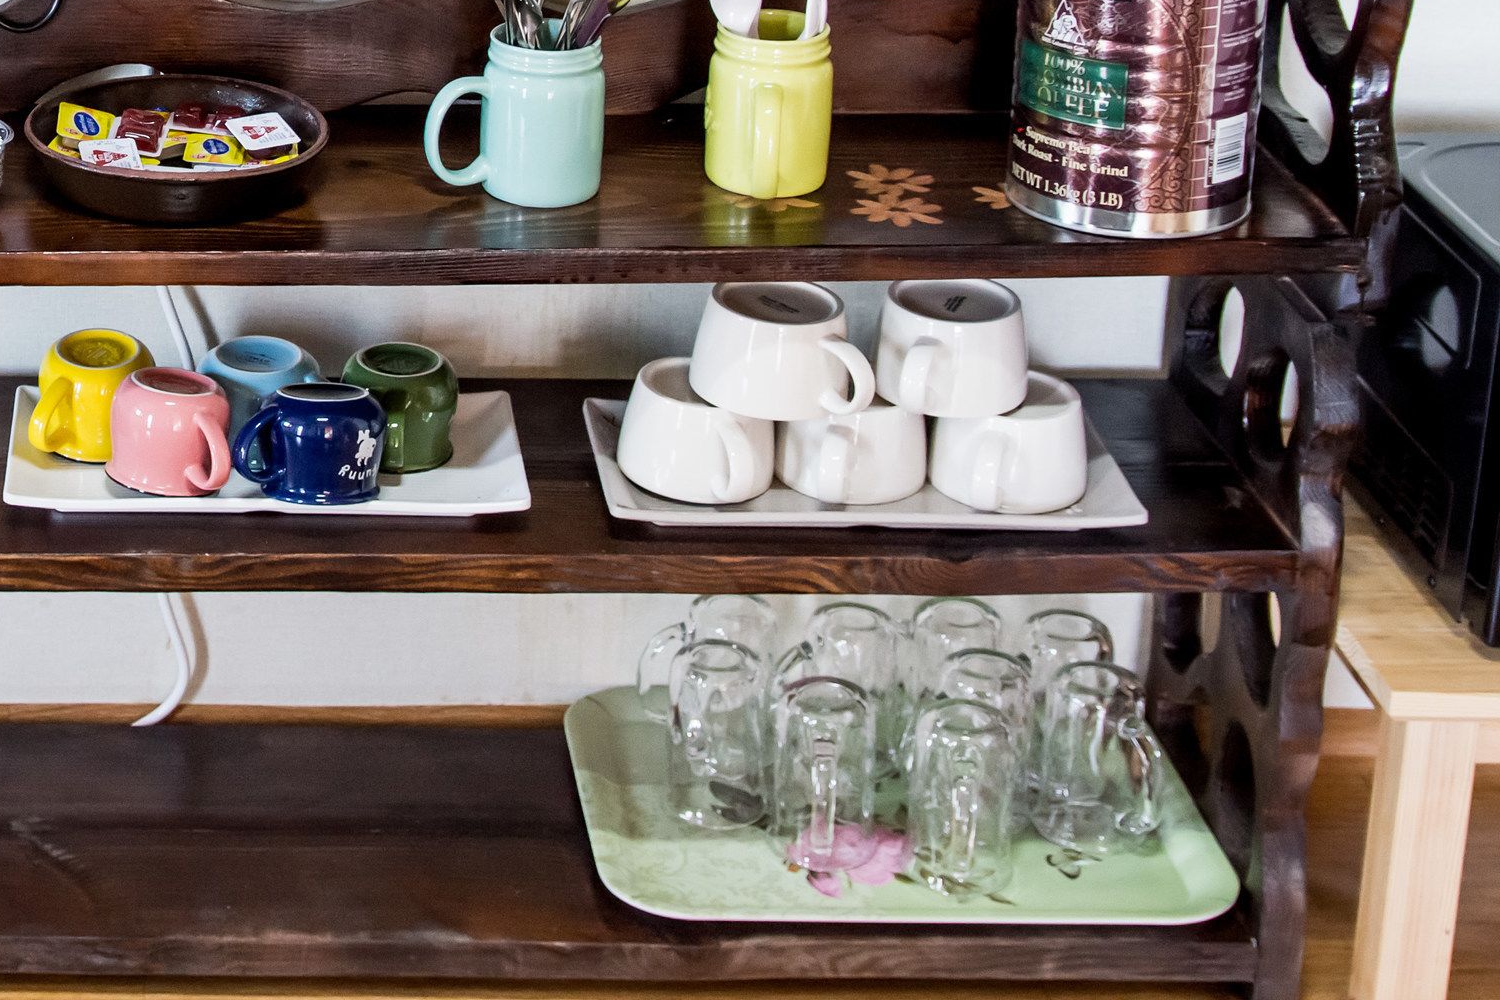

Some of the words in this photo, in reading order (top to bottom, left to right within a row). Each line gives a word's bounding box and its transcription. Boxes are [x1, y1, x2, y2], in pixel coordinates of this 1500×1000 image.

[1043, 52, 1086, 76] 100%
[1027, 143, 1053, 163] Roast
[1061, 156, 1088, 171] Fine
[1089, 162, 1129, 177] Grind
[1011, 160, 1026, 181] NET
[1025, 170, 1043, 189] WT
[1099, 191, 1124, 210] LB)
